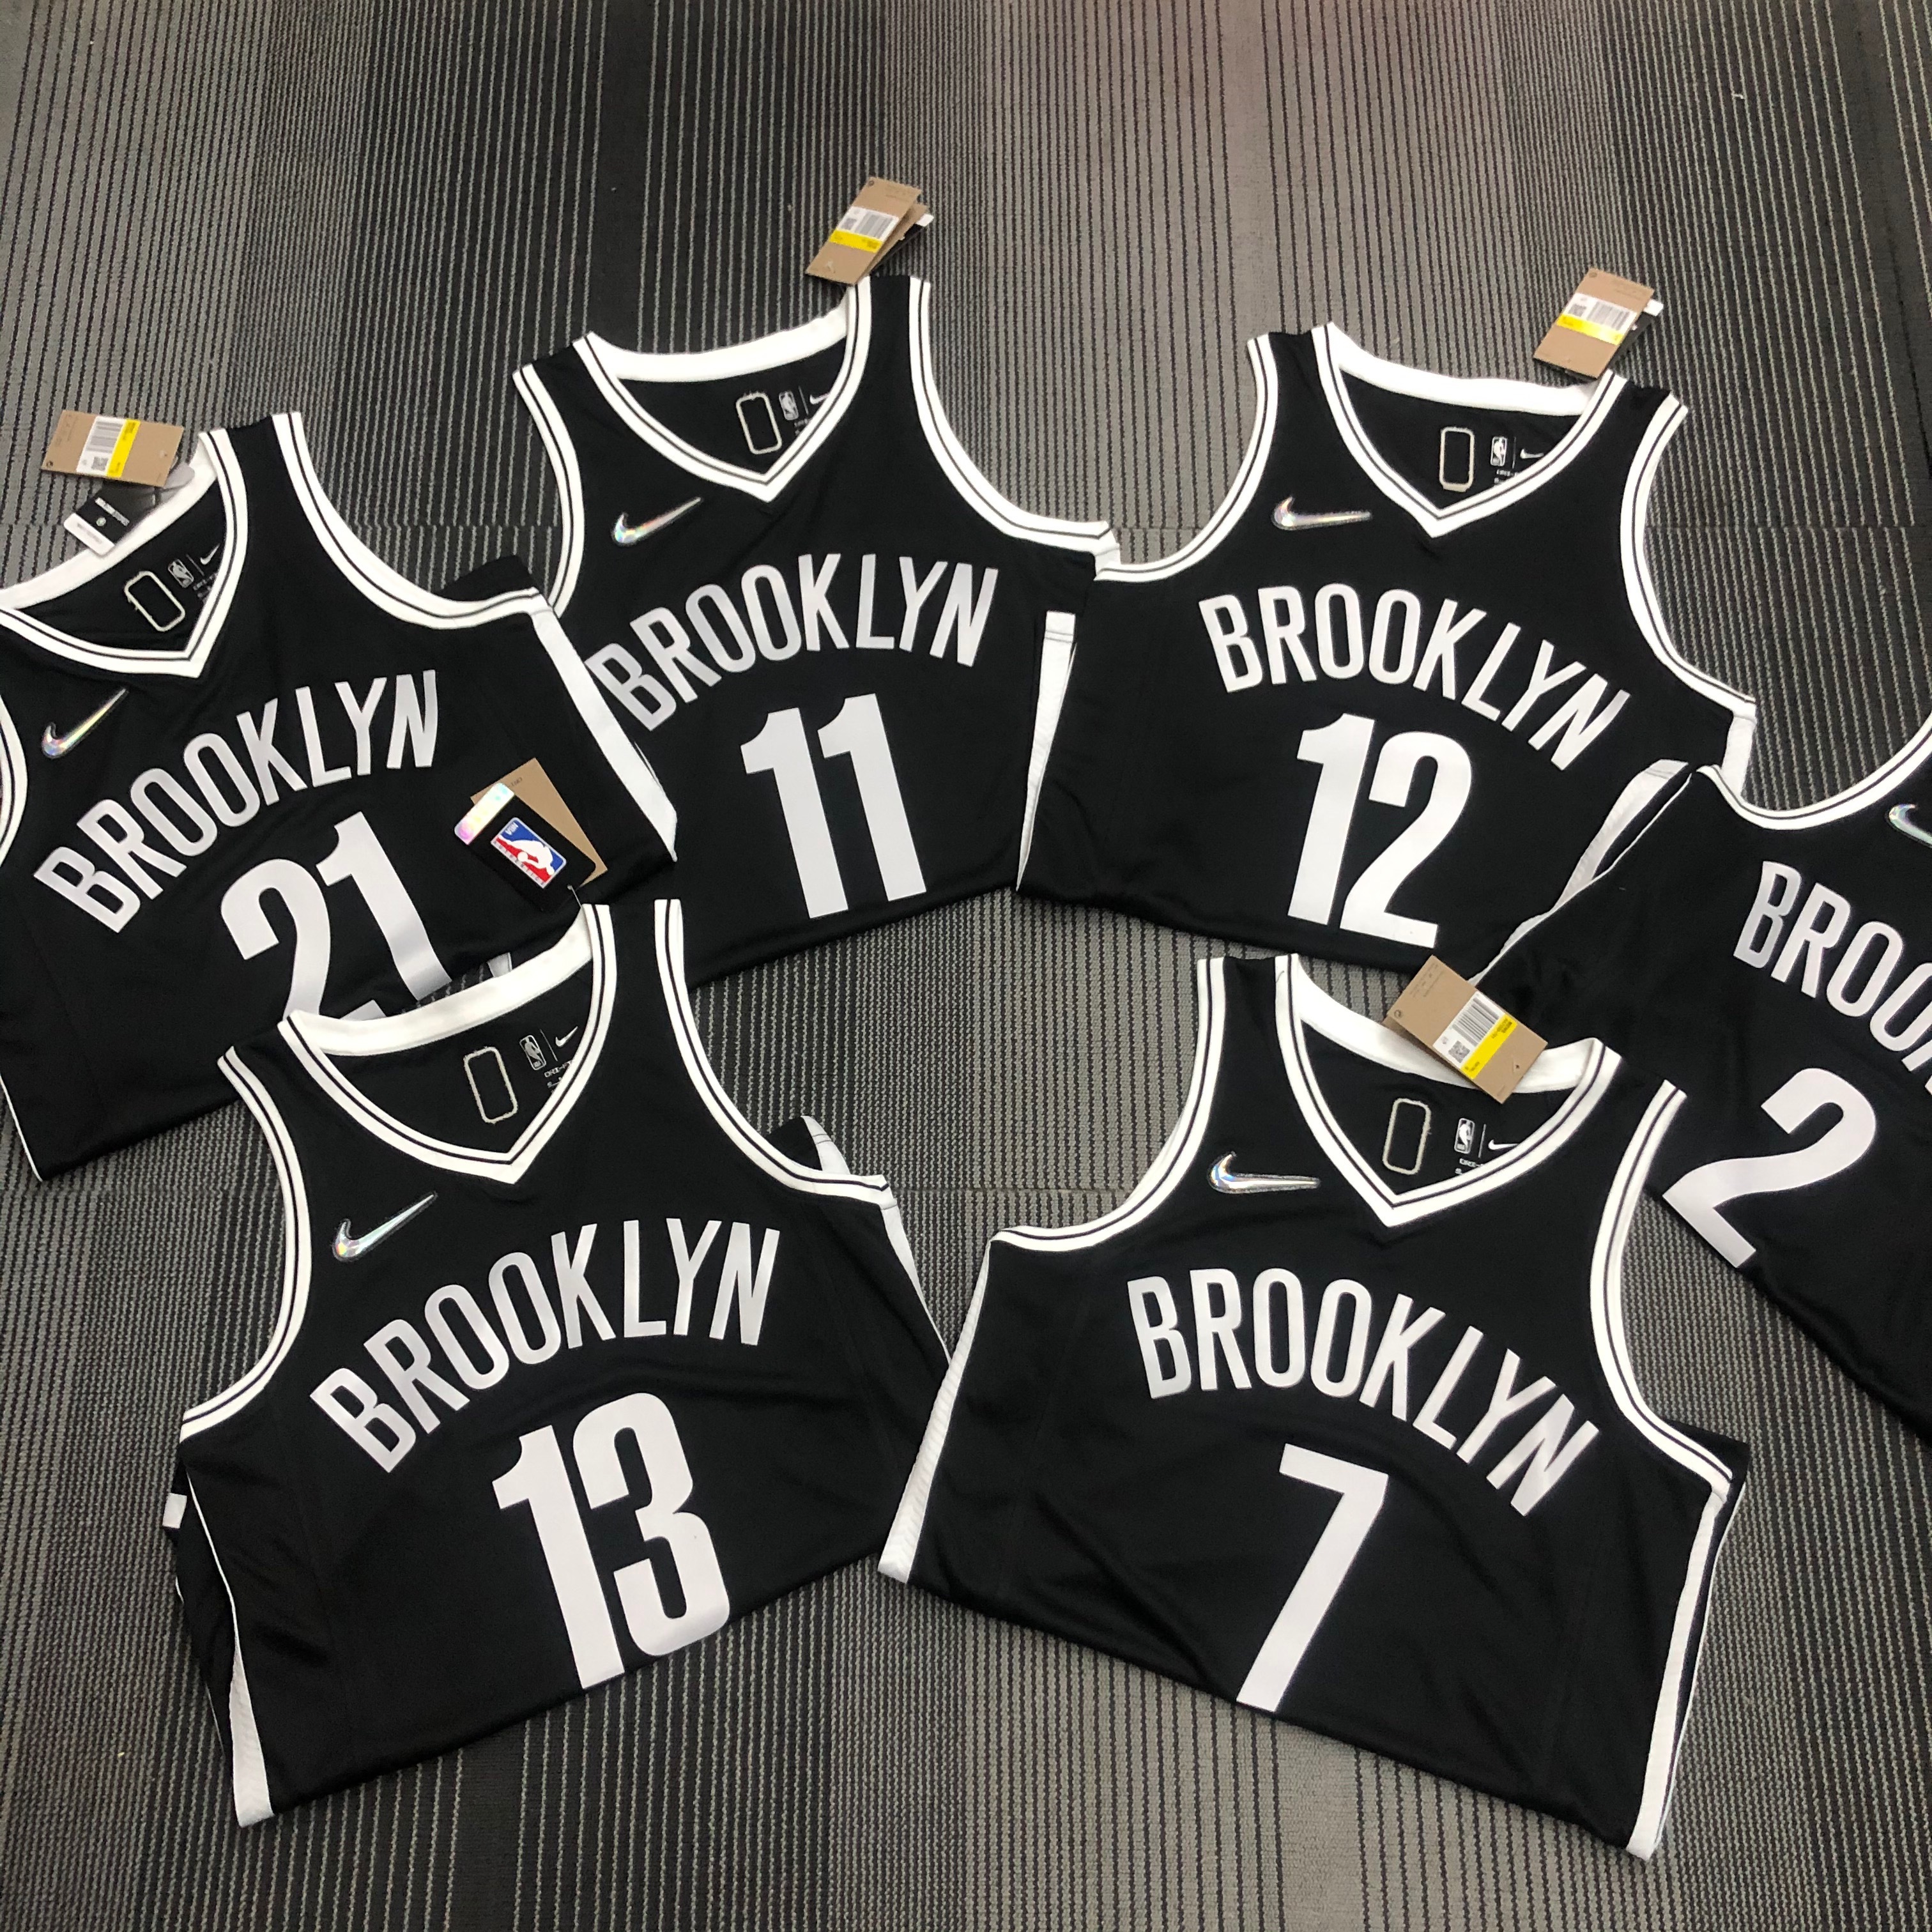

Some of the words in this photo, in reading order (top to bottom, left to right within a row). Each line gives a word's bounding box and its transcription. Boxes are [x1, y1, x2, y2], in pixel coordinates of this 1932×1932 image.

[584, 554, 998, 731] BROOKLYN
[1199, 583, 1630, 770] BROOKLYN
[34, 670, 438, 933] BROOKLYN
[221, 811, 452, 1022] 21
[740, 693, 926, 918] 11
[1288, 713, 1472, 948] 12
[1662, 1068, 1876, 1268] 2
[310, 1218, 779, 1473] BROOKLYN
[1128, 1268, 1599, 1516] BROOKLYN
[493, 1393, 730, 1689] 13
[1236, 1443, 1388, 1712] 7
